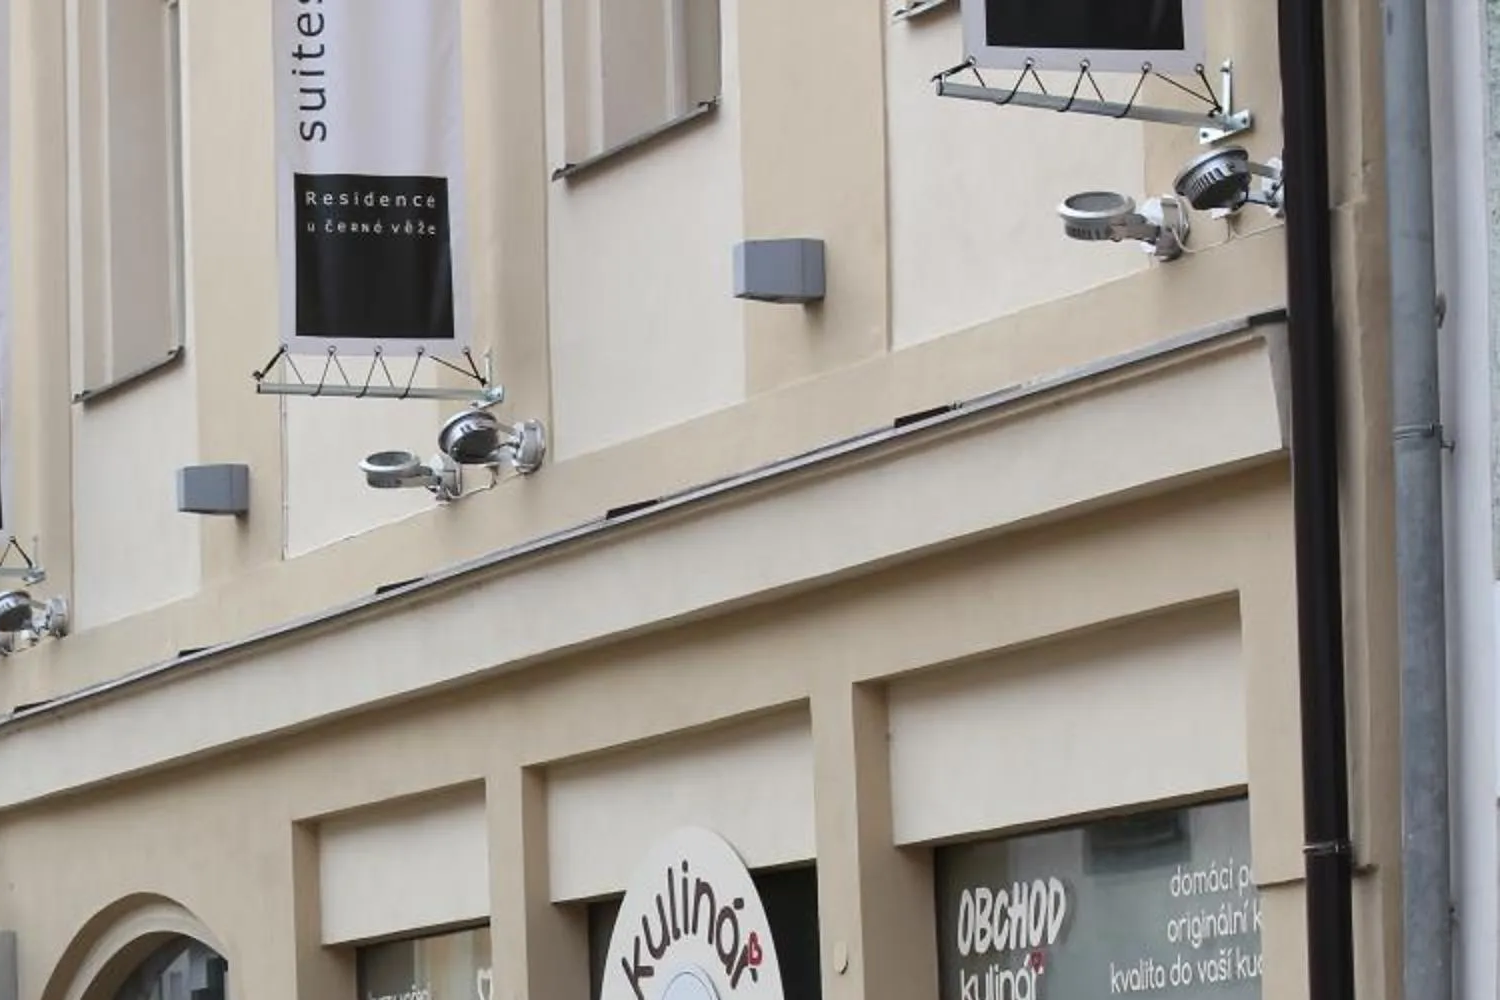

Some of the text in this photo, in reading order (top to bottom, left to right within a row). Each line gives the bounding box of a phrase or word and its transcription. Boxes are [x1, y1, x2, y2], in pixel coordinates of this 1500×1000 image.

[291, 0, 328, 142] suite
[304, 190, 436, 209] Residence
[306, 222, 316, 233] u
[1239, 864, 1252, 897] p
[957, 876, 1067, 956] OBCHOD
[1109, 957, 1167, 994] kvalita
[1169, 952, 1193, 987] do
[1199, 948, 1233, 984] vaší
